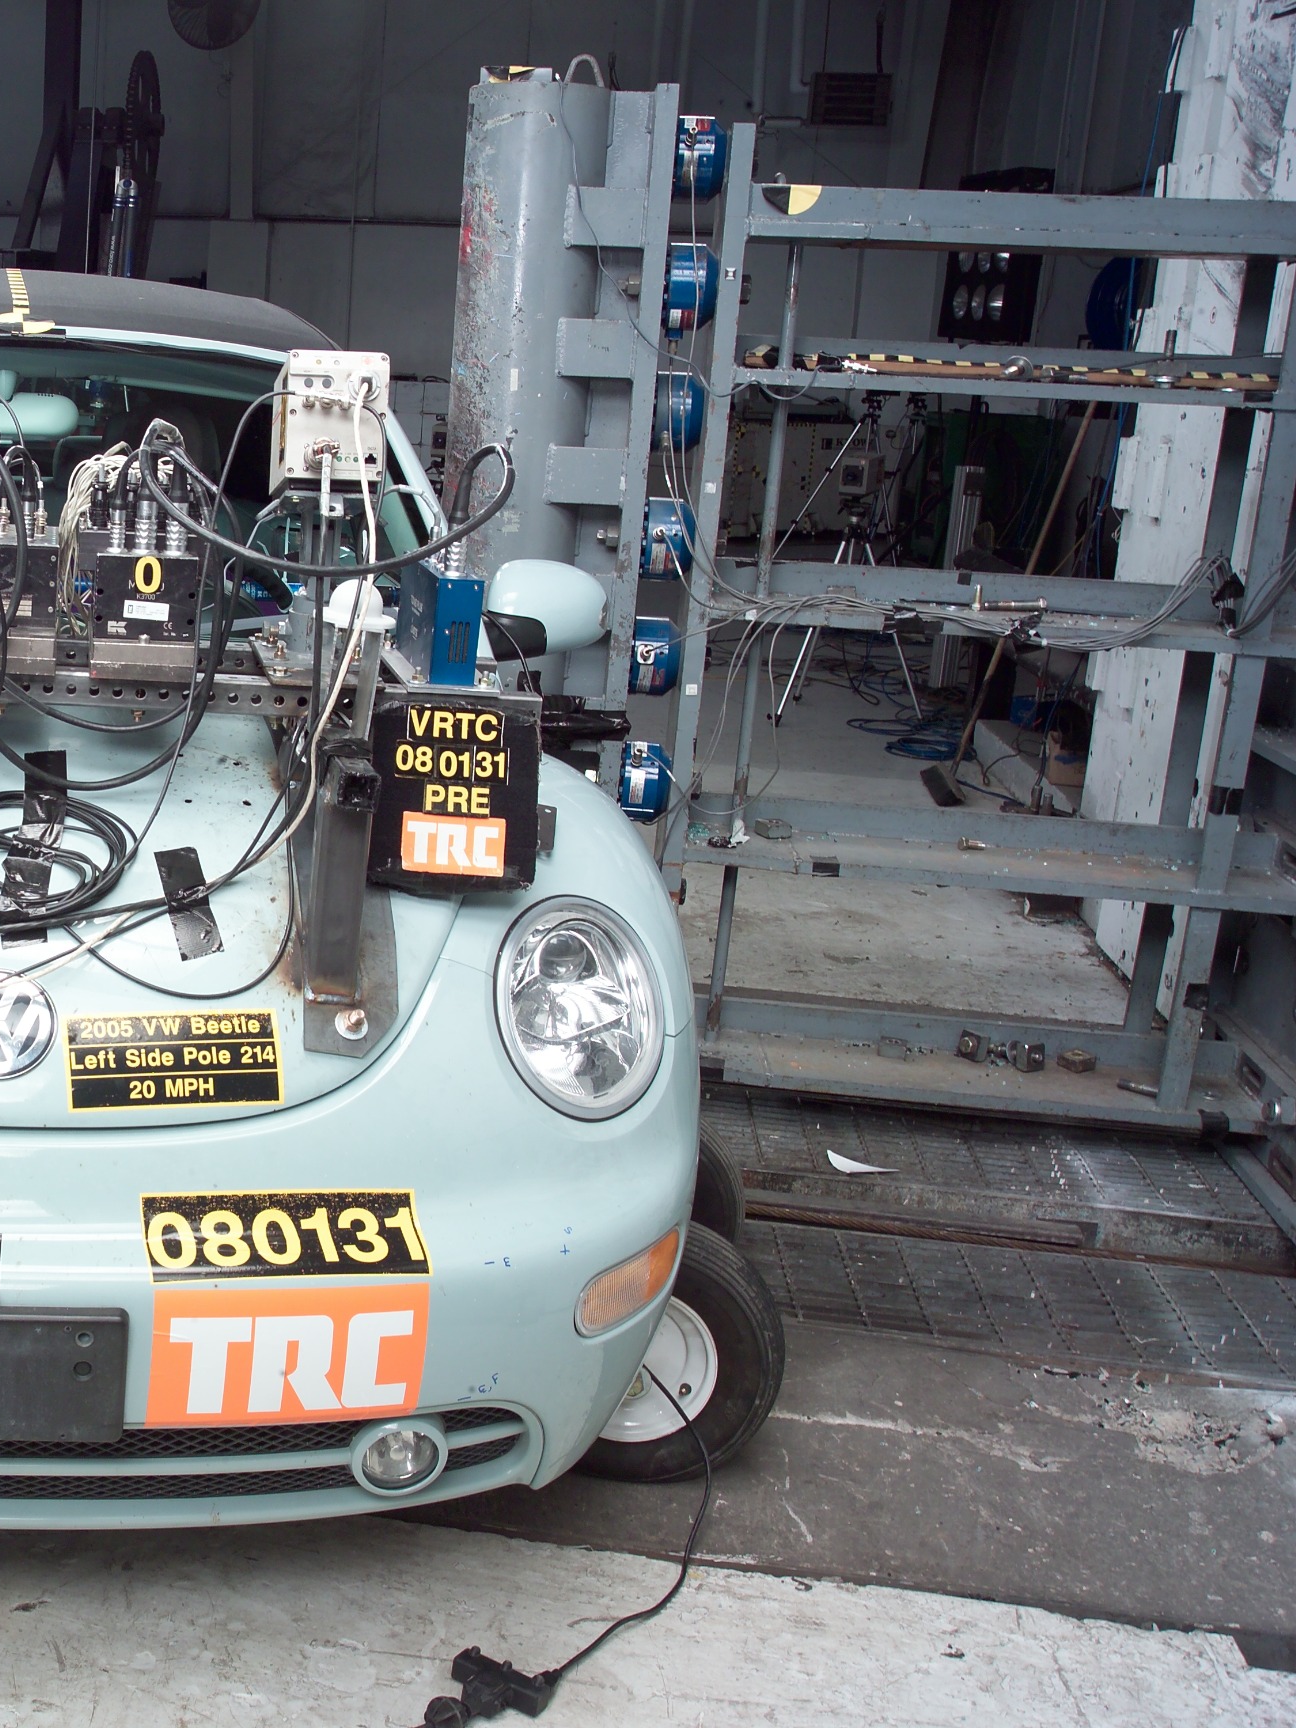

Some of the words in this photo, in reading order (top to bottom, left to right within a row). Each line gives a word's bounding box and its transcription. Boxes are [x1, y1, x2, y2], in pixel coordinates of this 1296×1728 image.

[135, 555, 162, 594] 0
[410, 709, 498, 742] VRTC
[425, 784, 490, 814] PRE
[407, 821, 499, 868] TRC
[80, 1020, 133, 1039] 2005
[143, 1018, 180, 1036] VW
[191, 1015, 261, 1035] Beetle
[70, 1049, 116, 1070] Left
[125, 1048, 175, 1068] Side
[183, 1046, 231, 1066] Pole
[240, 1045, 275, 1064] 214
[129, 1080, 156, 1099] 20
[165, 1078, 215, 1097] MPH
[147, 1206, 428, 1271] 080131
[169, 1309, 415, 1415] TRC
